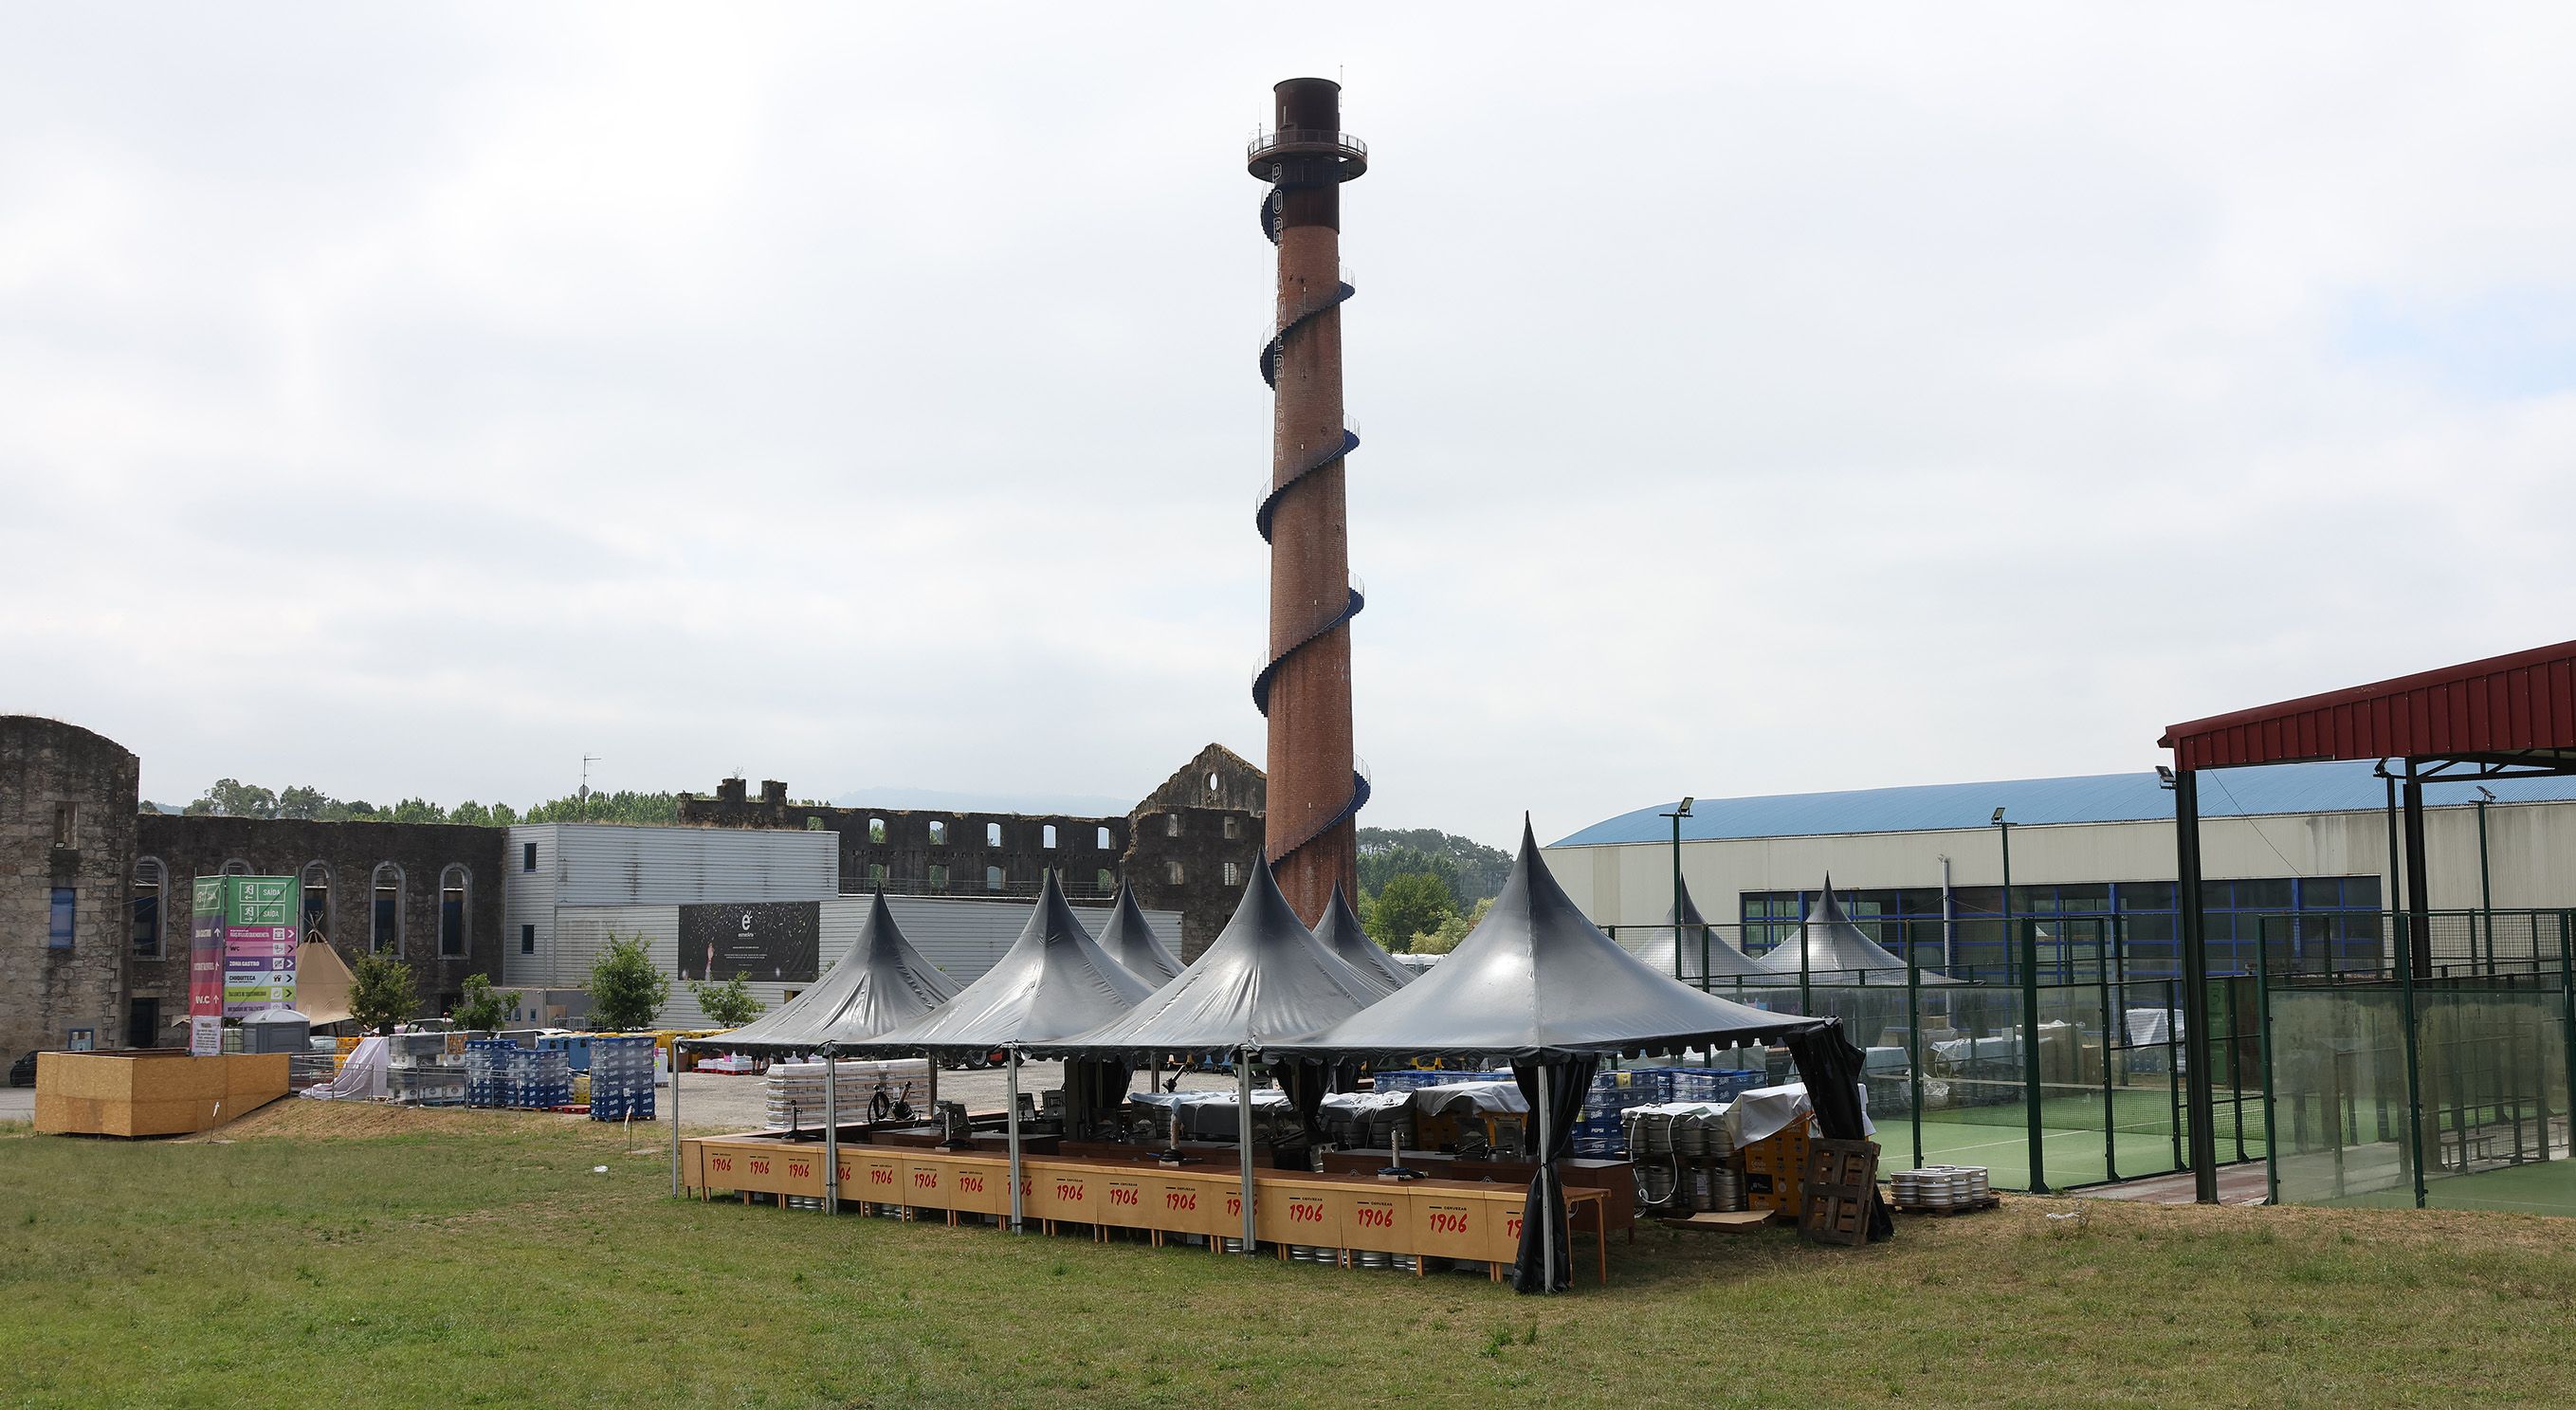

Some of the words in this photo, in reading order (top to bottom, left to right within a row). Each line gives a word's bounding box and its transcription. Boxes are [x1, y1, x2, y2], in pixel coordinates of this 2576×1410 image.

[263, 888, 281, 896] SAÍDA
[263, 909, 280, 918] SAÍDA
[712, 1158, 731, 1172] 1906
[750, 1161, 770, 1175] 1906
[789, 1163, 810, 1178] 1906
[838, 1166, 851, 1181] 06
[870, 1167, 893, 1184] 1906
[914, 1172, 938, 1188] 1906
[959, 1177, 984, 1193] 1906
[1007, 1181, 1032, 1197] 106
[1056, 1183, 1084, 1201] 1906
[1109, 1188, 1139, 1206] 1906
[1166, 1193, 1197, 1211] 1906
[1289, 1203, 1324, 1223] 1906
[1358, 1208, 1394, 1228] 1906
[1430, 1213, 1468, 1234] 1906
[1507, 1218, 1523, 1240] 19
